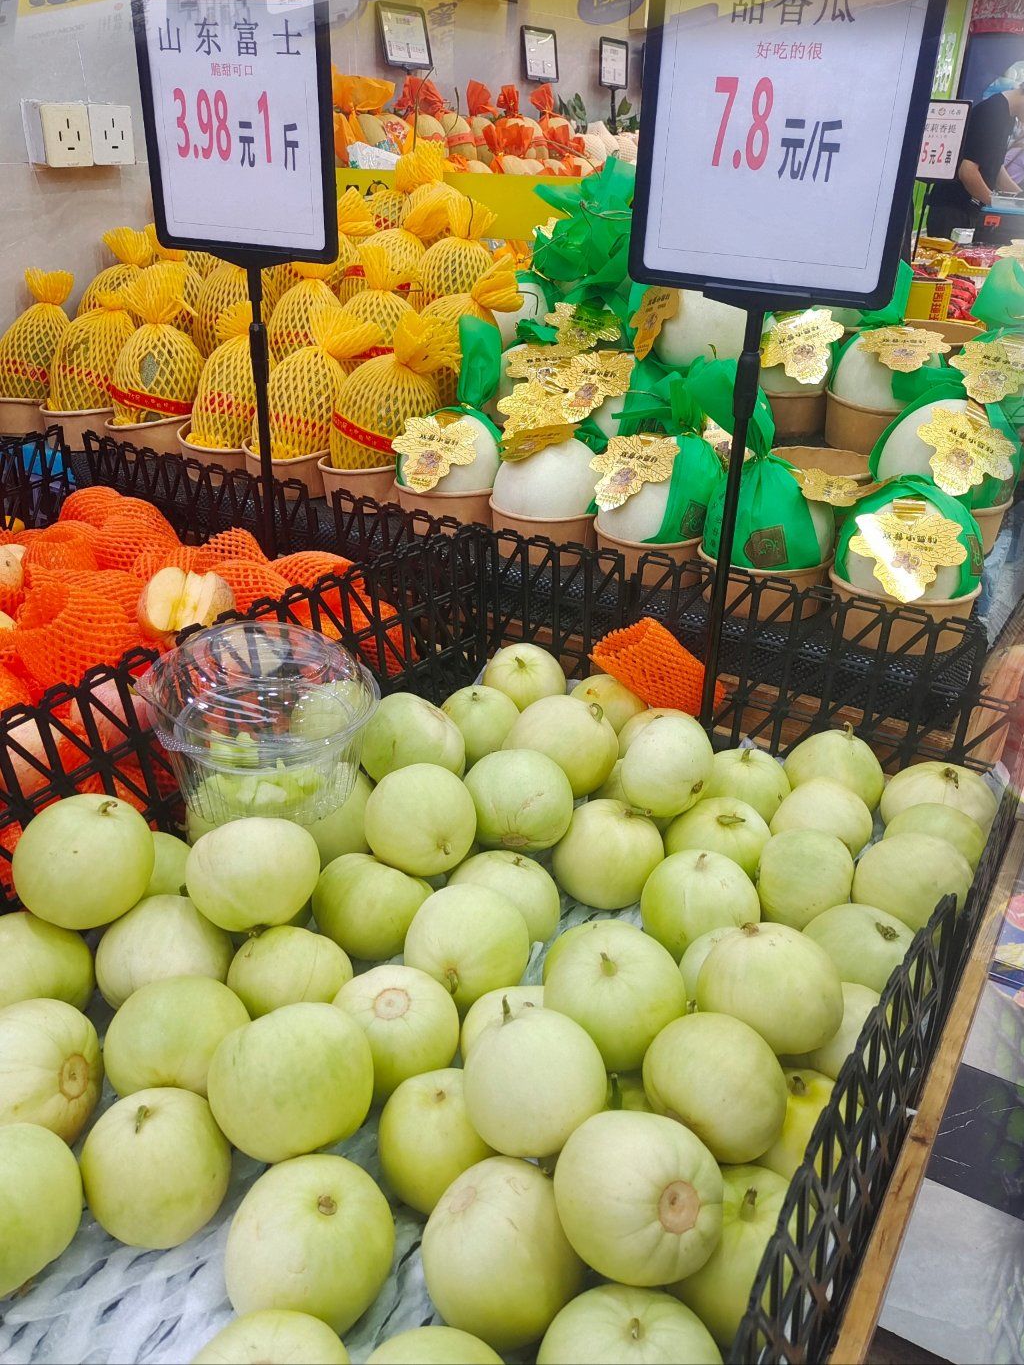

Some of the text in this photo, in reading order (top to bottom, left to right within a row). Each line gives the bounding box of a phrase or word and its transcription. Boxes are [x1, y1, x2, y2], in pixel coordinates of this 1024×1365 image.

[158, 17, 303, 57] 山东富士
[756, 41, 823, 60] 好吃的很
[210, 62, 254, 77] 脆甜可口
